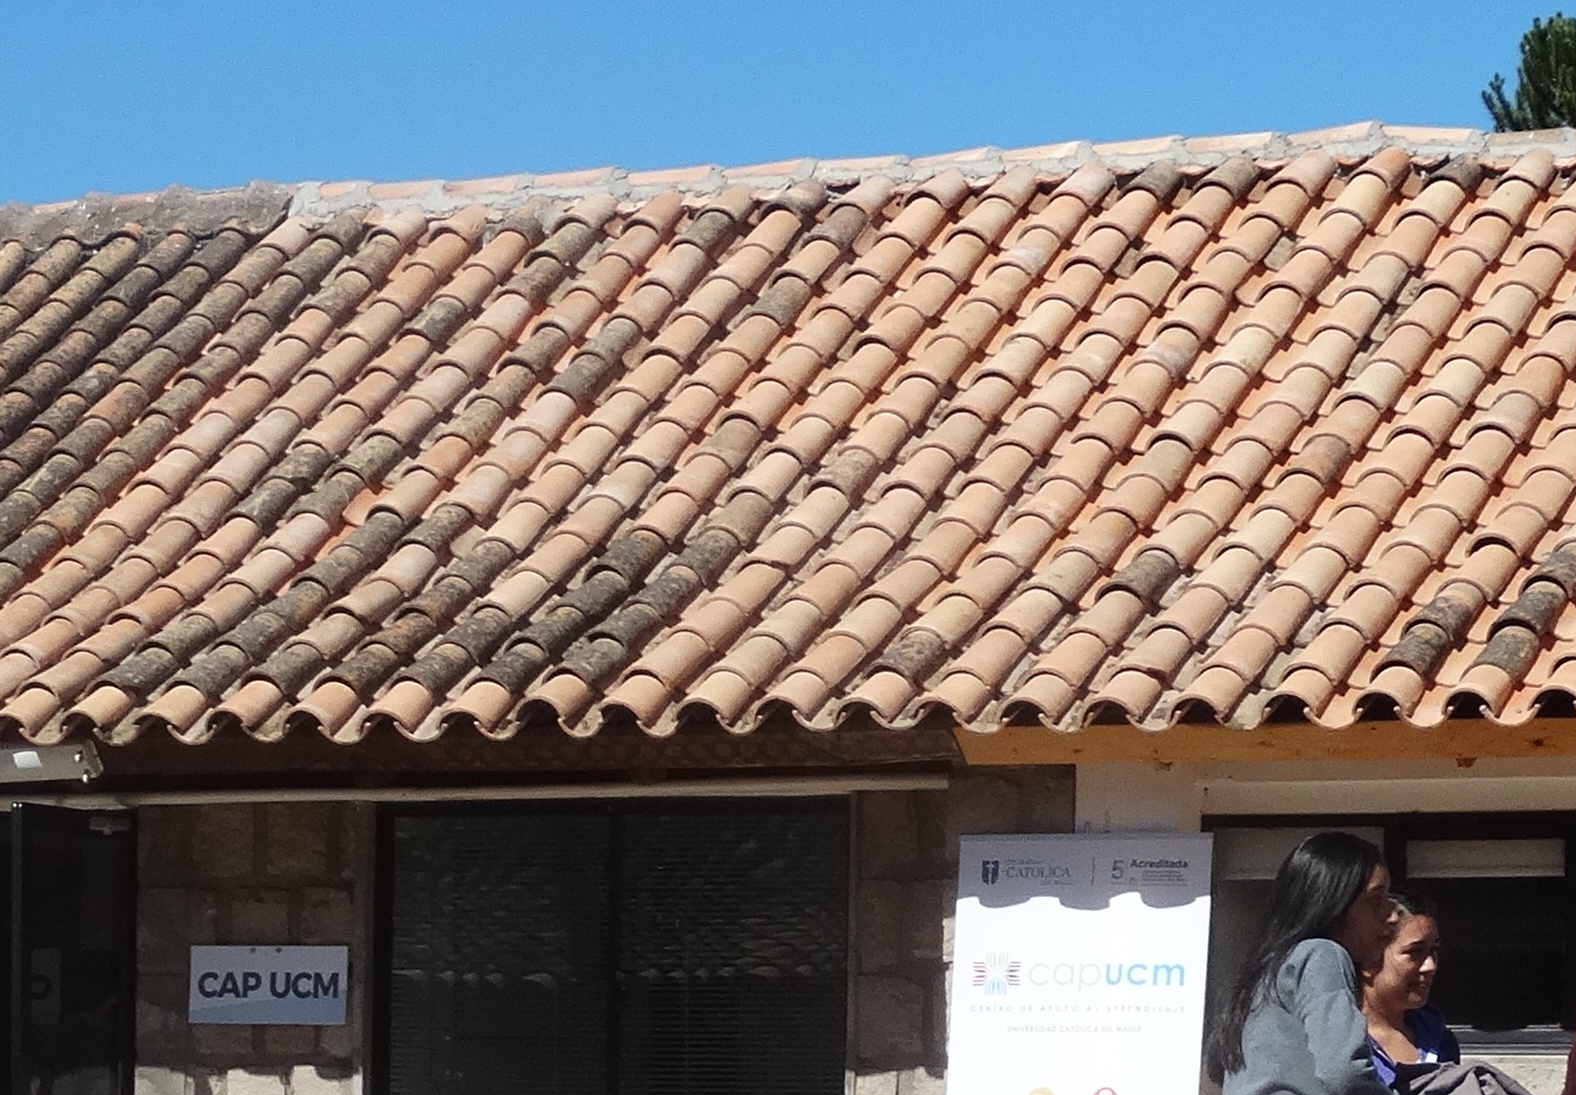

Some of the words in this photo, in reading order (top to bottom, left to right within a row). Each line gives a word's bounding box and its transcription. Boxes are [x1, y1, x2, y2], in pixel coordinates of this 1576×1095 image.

[1130, 859, 1188, 868] Acreditada
[198, 971, 262, 998] CAP
[269, 971, 340, 998] UCM
[970, 1005, 1013, 1013] CENTRO
[1020, 1005, 1033, 1013] DE
[1040, 1005, 1078, 1013] APOYO
[1106, 1005, 1186, 1013] APRENDIZAJE
